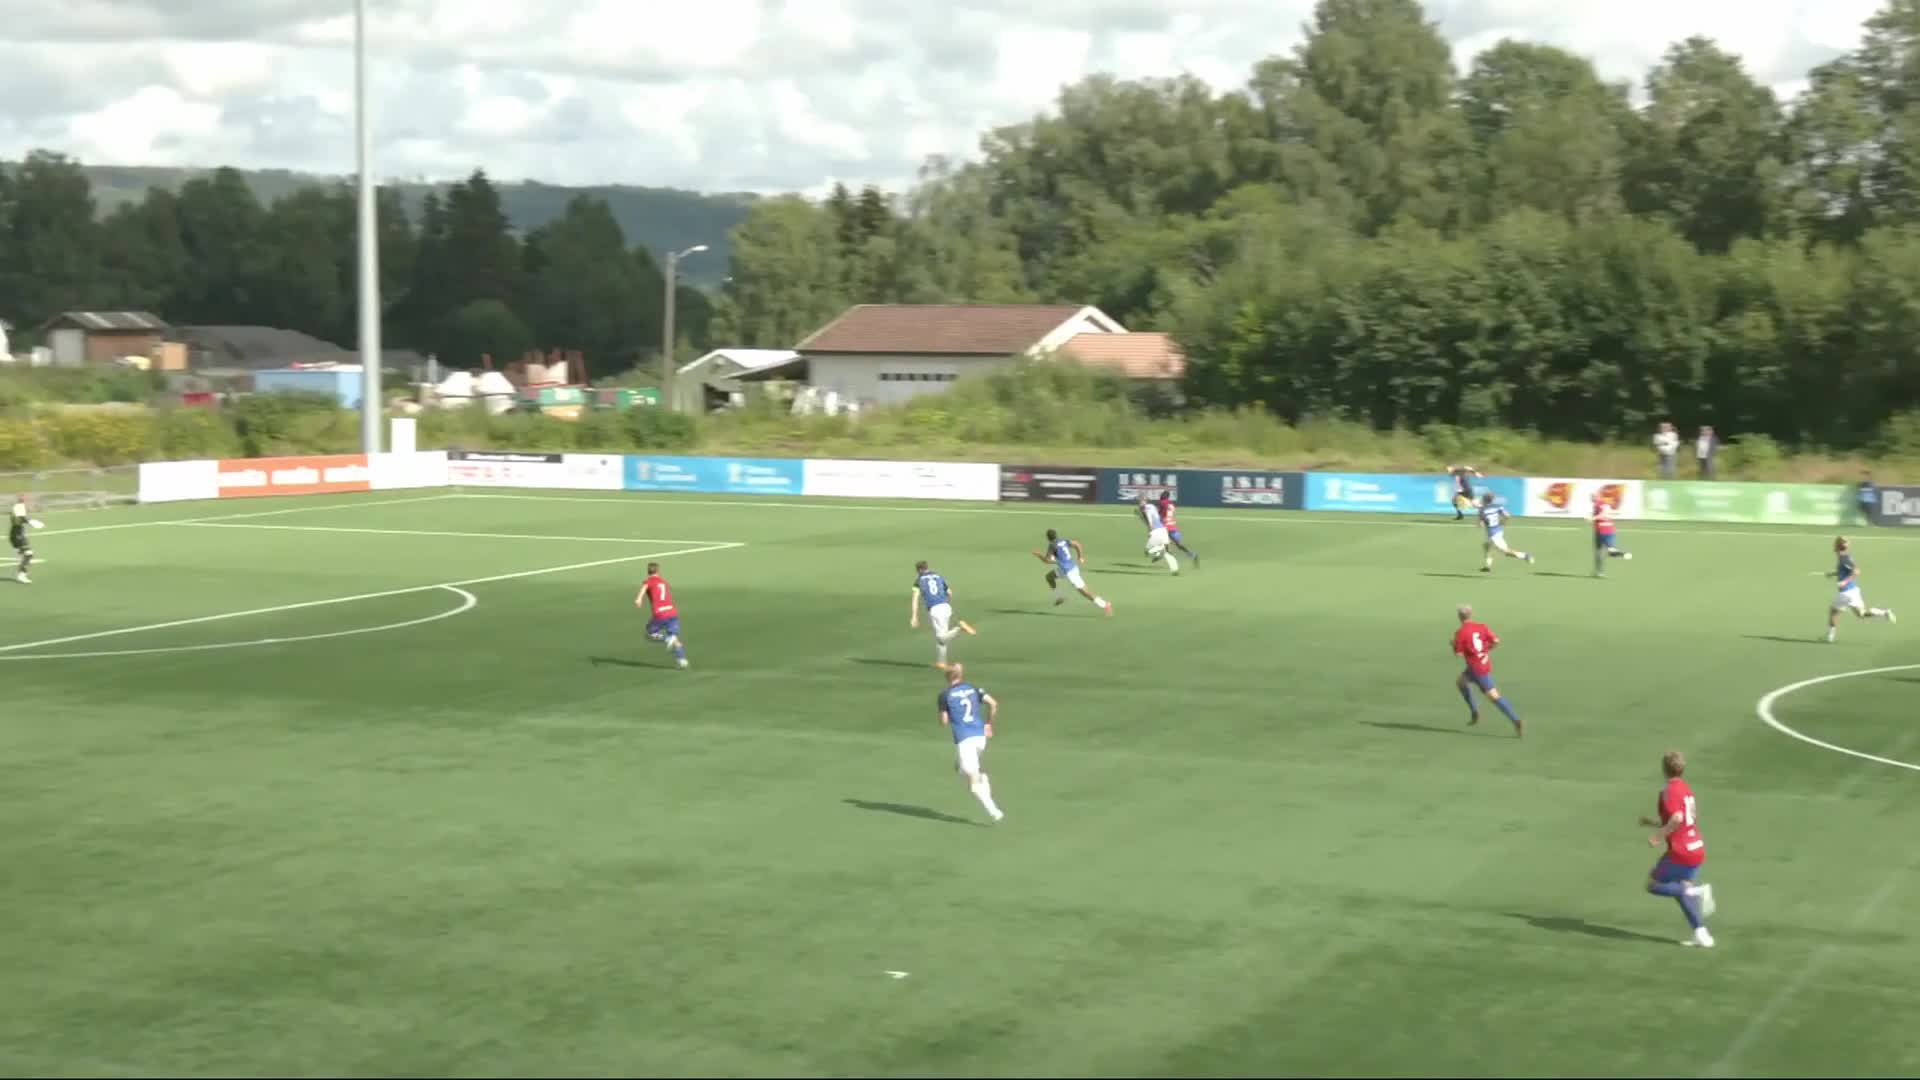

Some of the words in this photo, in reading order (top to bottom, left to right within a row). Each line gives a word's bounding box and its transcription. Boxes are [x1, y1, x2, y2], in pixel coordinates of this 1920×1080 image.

[657, 583, 666, 601] 7
[927, 579, 938, 596] 8
[1472, 631, 1483, 652] 6
[960, 698, 974, 722] 2
